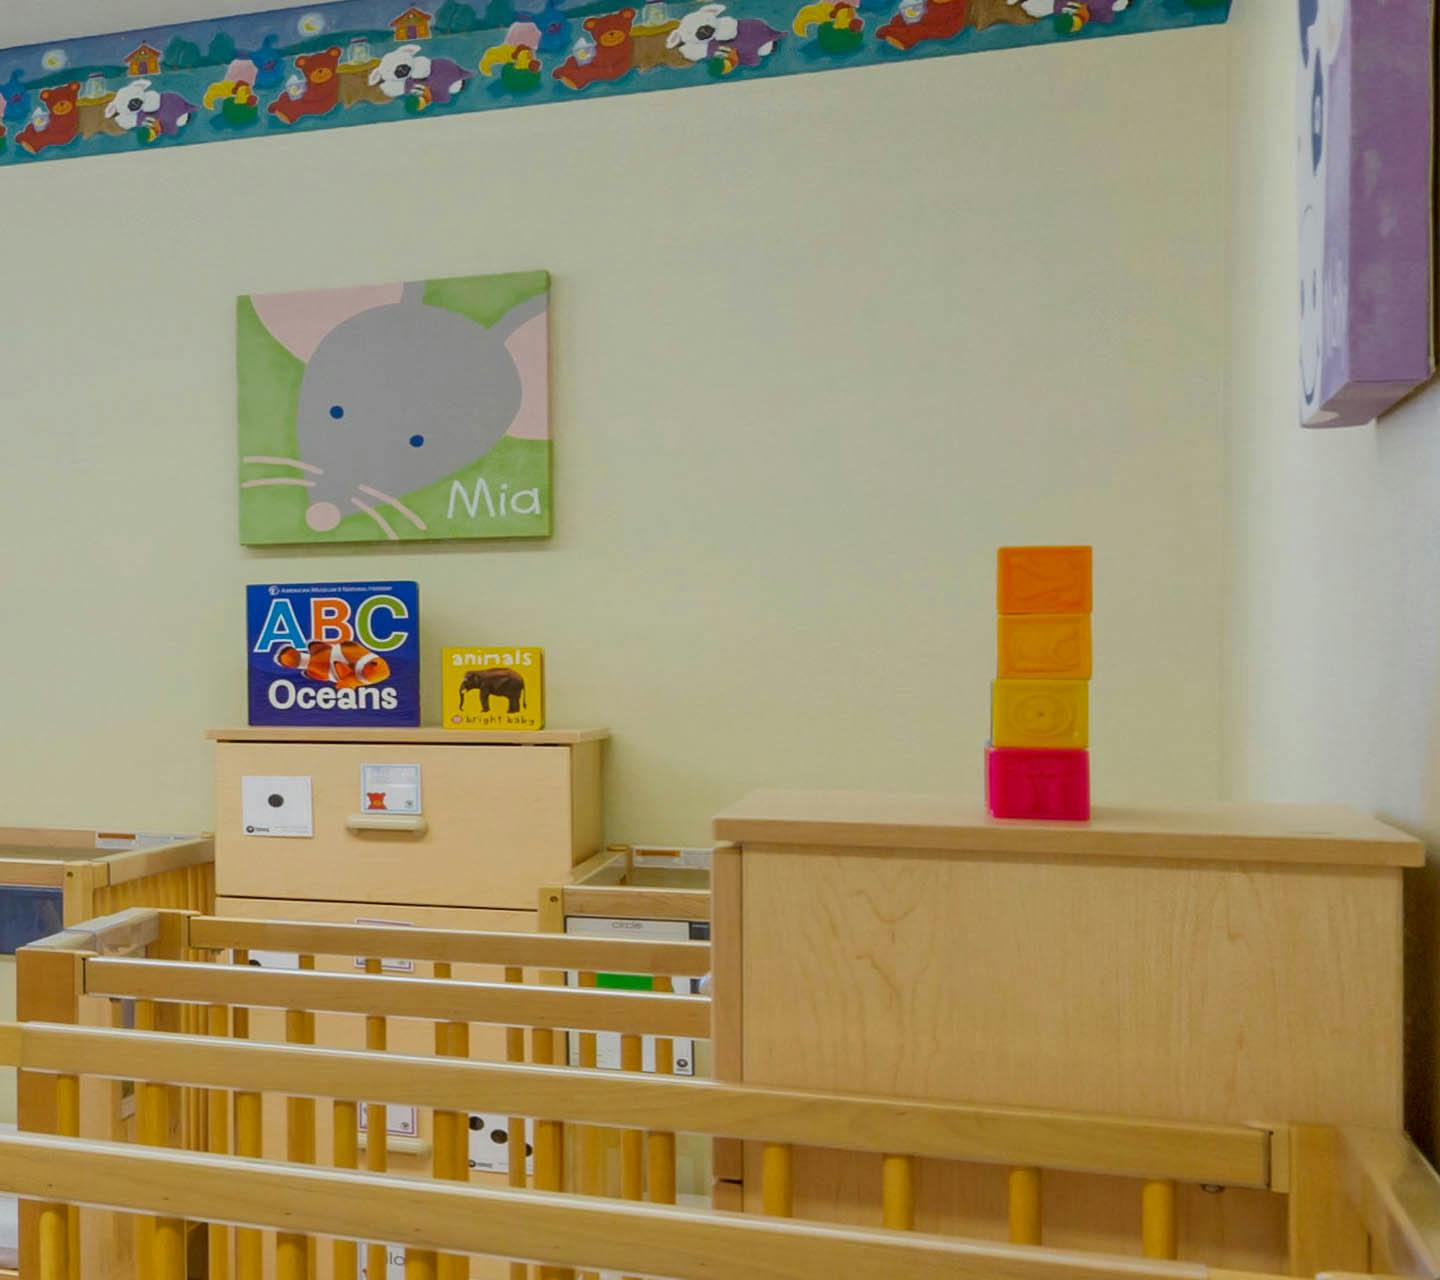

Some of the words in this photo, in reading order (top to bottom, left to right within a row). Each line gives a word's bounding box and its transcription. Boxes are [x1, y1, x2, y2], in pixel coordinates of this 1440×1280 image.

[447, 478, 541, 520] Mia
[254, 594, 409, 653] ABC
[452, 650, 532, 666] animals
[268, 679, 398, 710] Oceans
